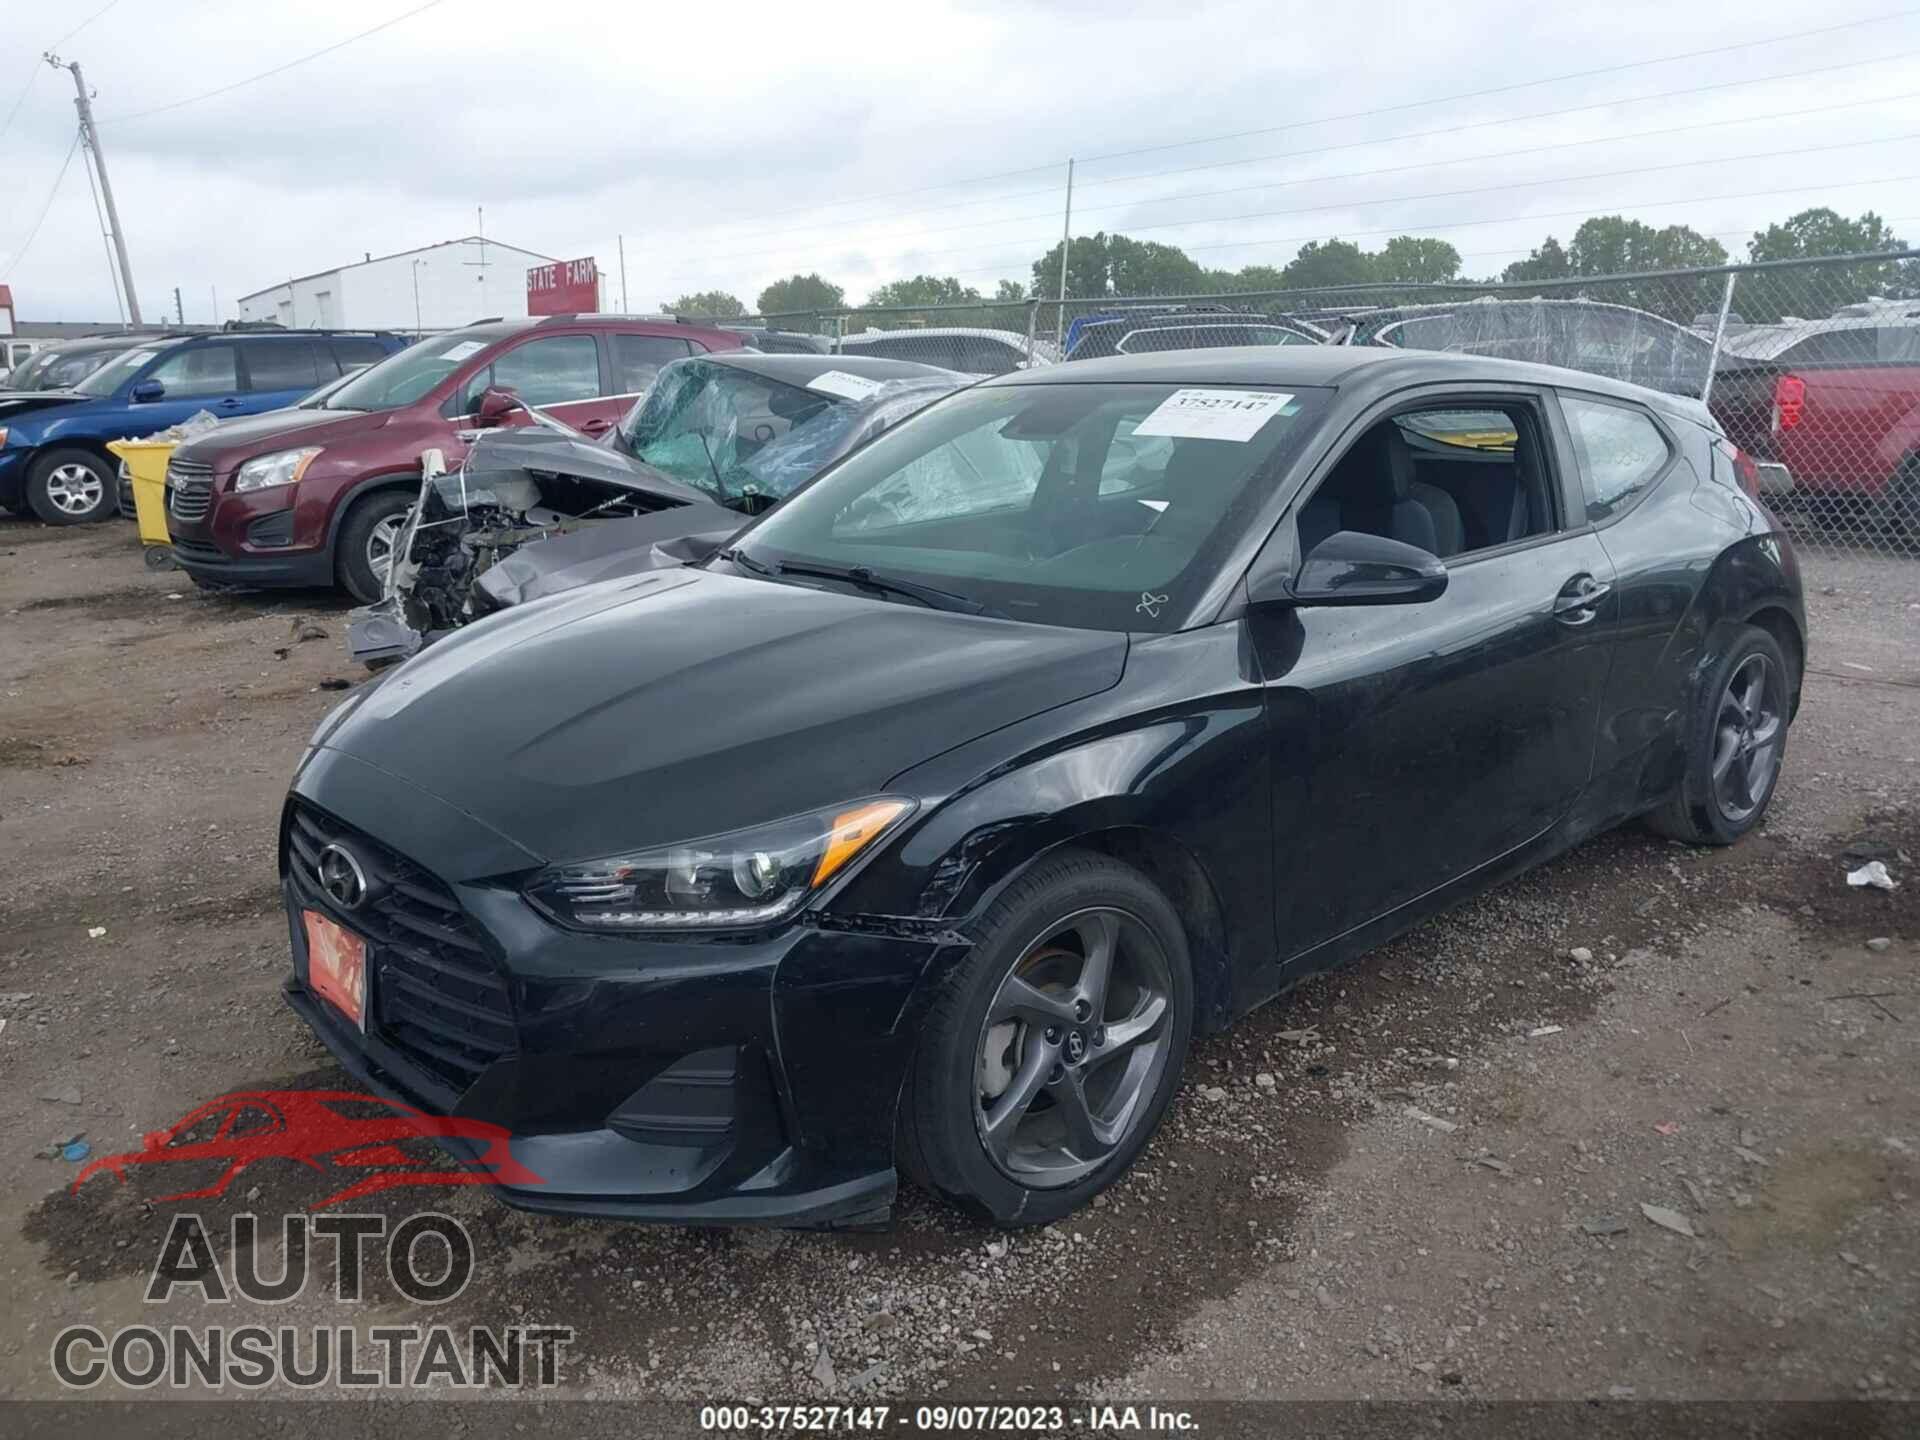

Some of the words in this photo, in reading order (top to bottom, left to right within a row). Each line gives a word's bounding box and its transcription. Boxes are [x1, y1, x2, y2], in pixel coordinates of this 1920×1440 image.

[527, 266, 556, 292] STATE
[566, 259, 594, 285] FARM
[1171, 397, 1269, 411] 37527147
